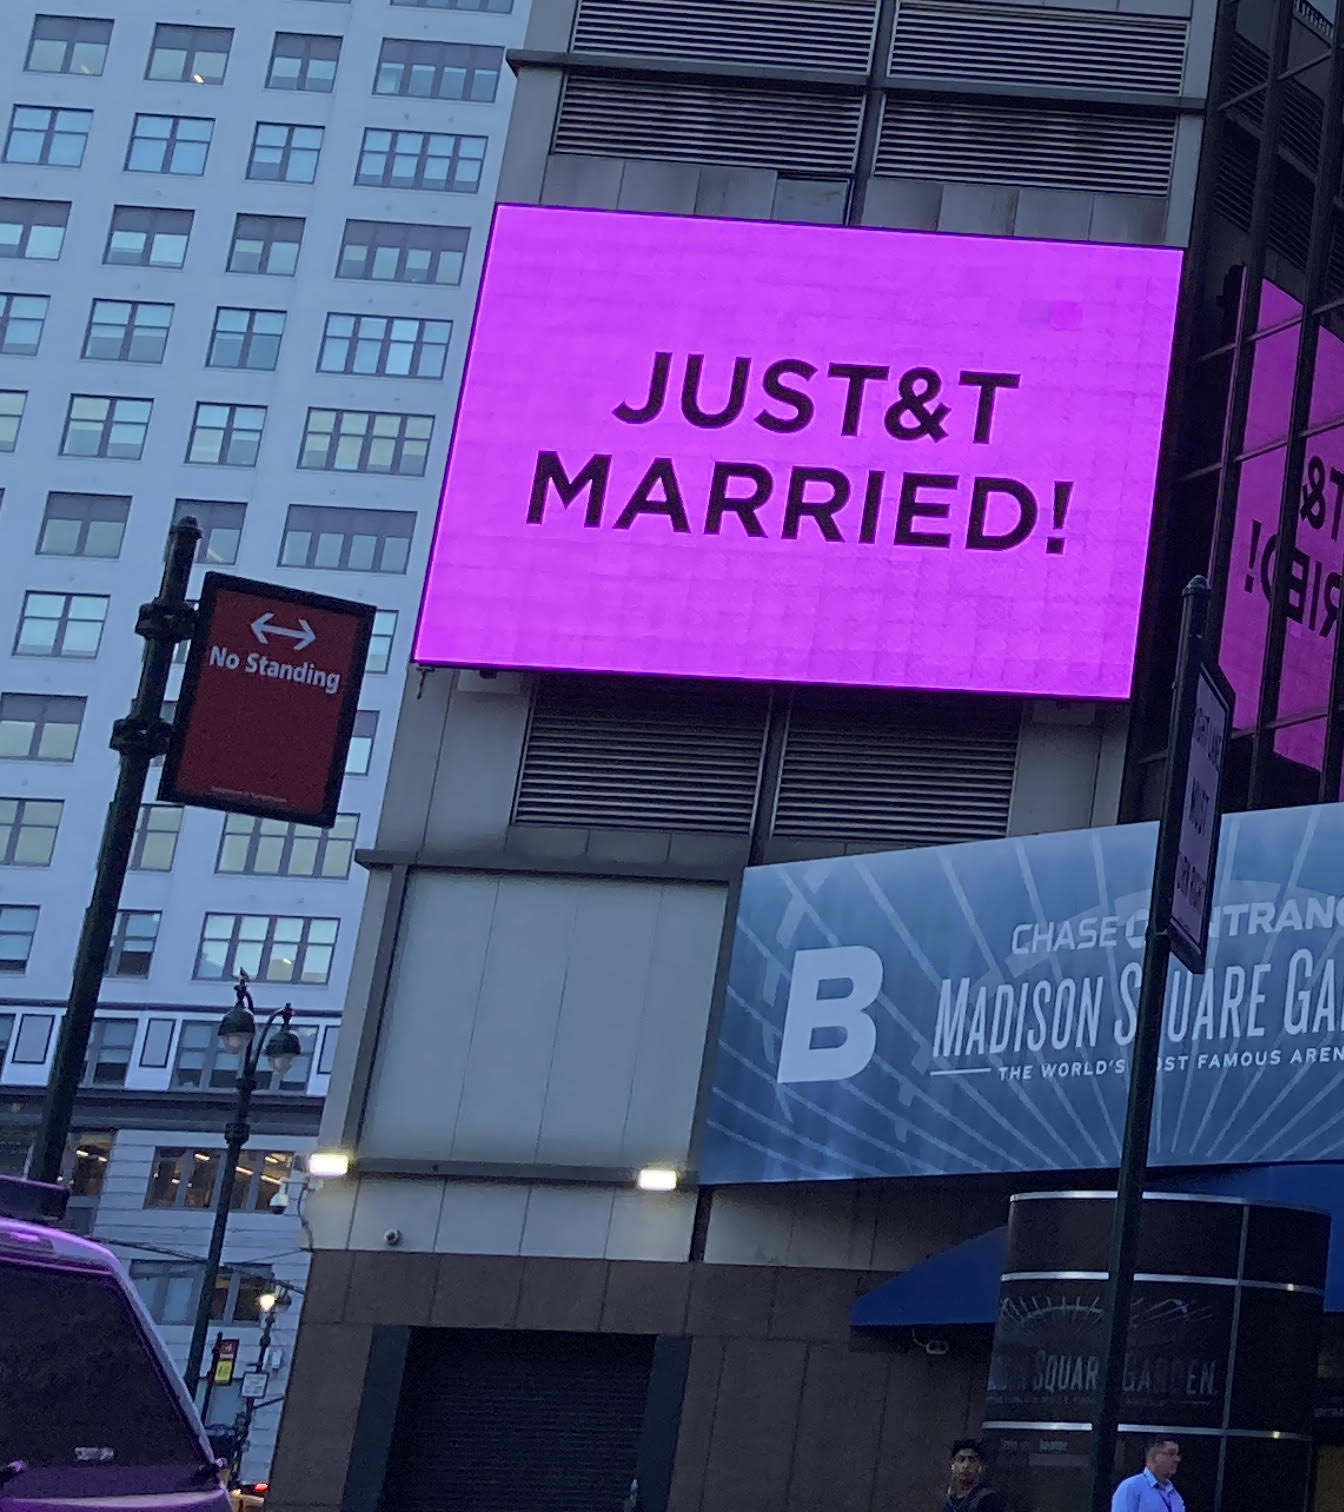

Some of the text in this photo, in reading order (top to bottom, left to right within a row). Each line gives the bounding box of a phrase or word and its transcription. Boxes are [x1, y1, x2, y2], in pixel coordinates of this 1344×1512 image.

[612, 351, 1021, 444] JUST&T
[526, 450, 1074, 554] MARRIED!
[209, 645, 341, 694] No Standing
[1011, 915, 1120, 955] CHASE
[777, 945, 884, 1083] B
[932, 977, 1104, 1057] MADISON
[1114, 962, 1272, 1046] SUARE
[999, 1064, 1032, 1081] THE
[1041, 1058, 1126, 1078] WORLD'S
[1198, 1050, 1281, 1069] FAMOUS
[1033, 1349, 1100, 1394] SQUAR
